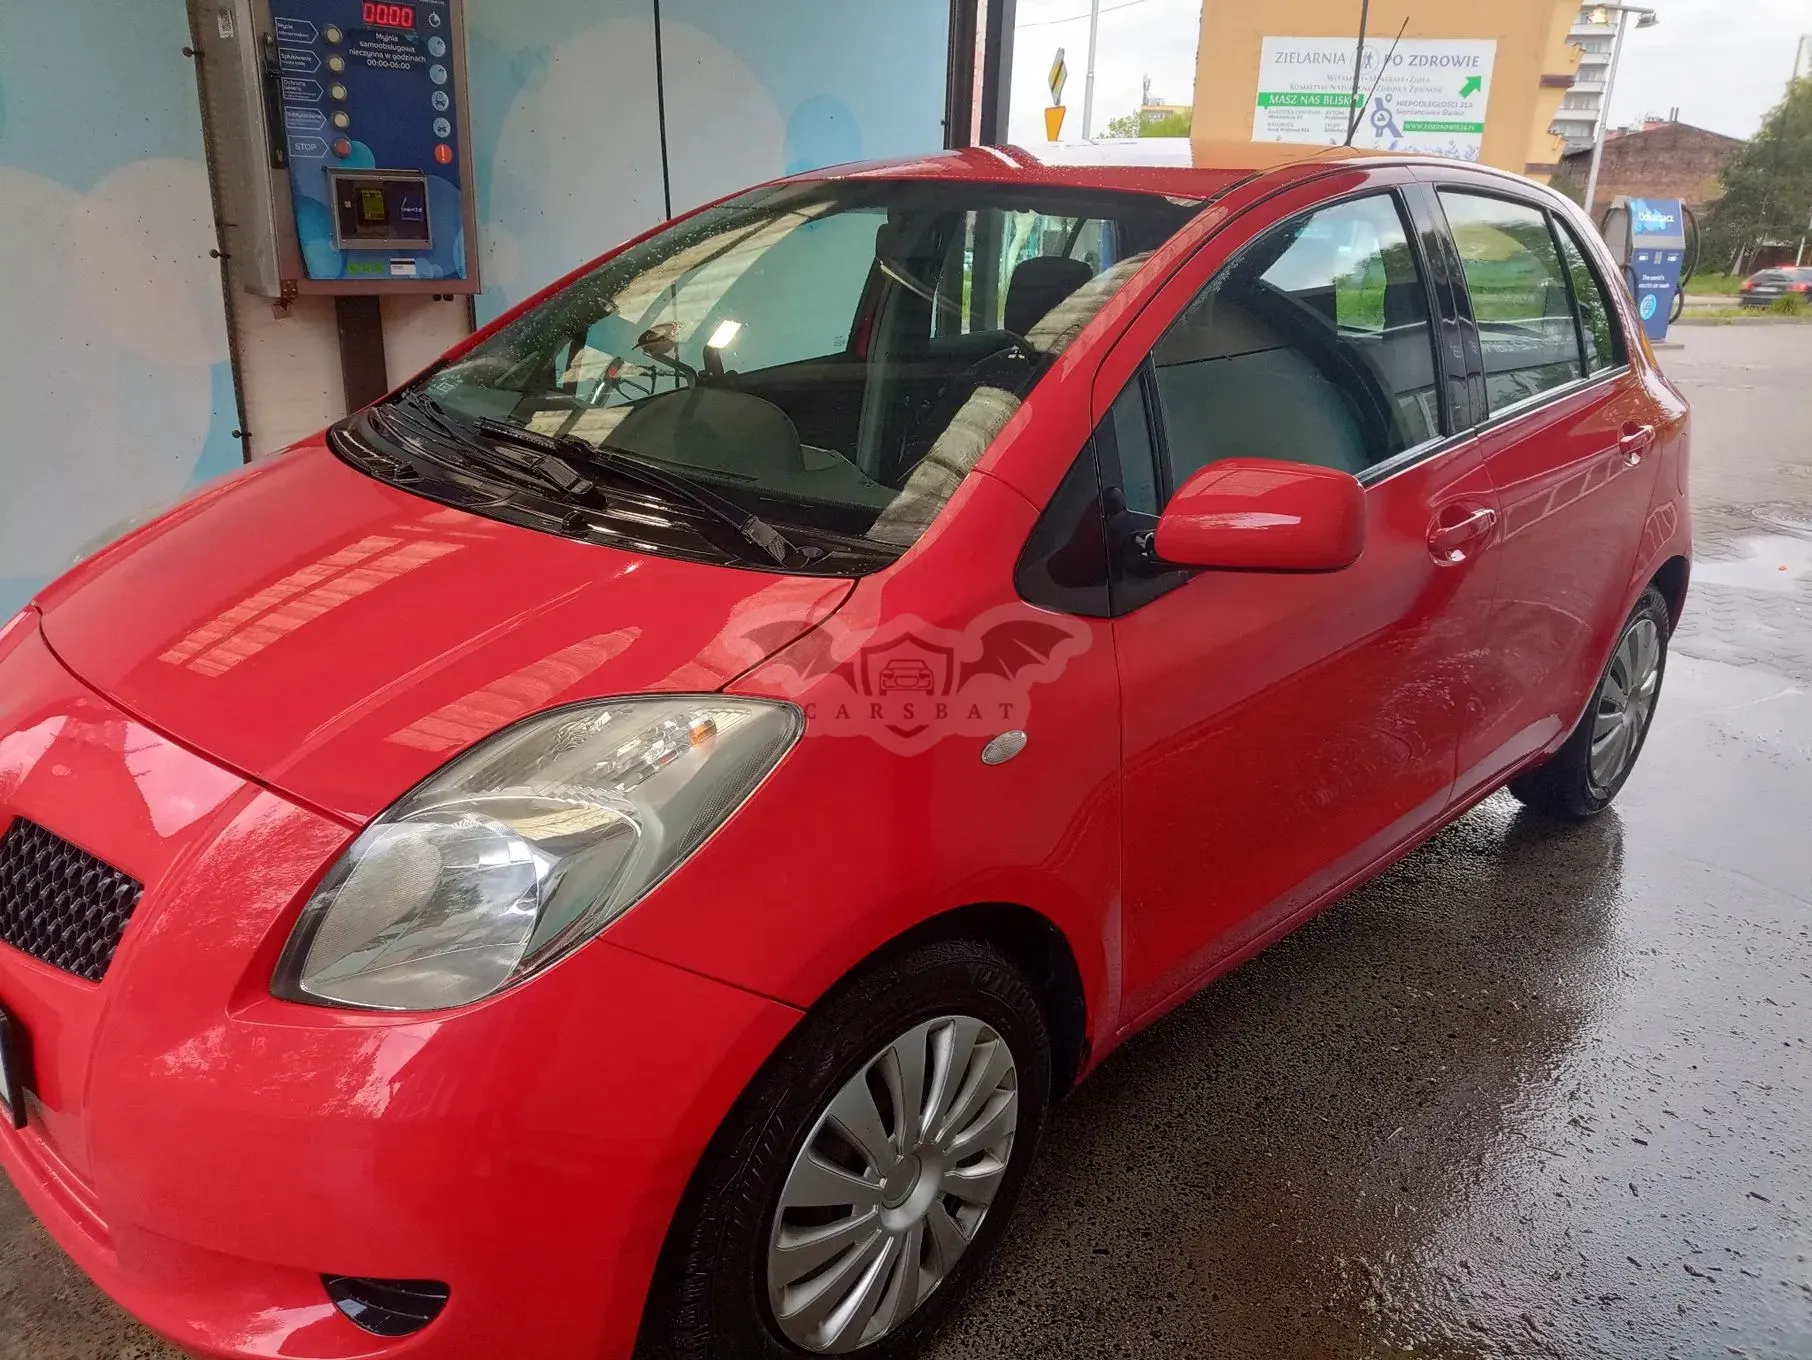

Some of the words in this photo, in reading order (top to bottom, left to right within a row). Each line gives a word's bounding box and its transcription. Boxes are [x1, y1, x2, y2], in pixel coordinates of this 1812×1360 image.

[375, 33, 399, 42] Myjnia
[359, 41, 416, 53] samoobsługowa
[349, 49, 384, 59] nieczynna
[392, 53, 427, 63] godzinach
[1275, 51, 1346, 65] ZIELARNIA
[1385, 54, 1403, 66] PO
[1409, 54, 1480, 68] ZDROWIE
[367, 59, 411, 70] 00:00-06:00
[1269, 94, 1297, 104] MASZ
[1300, 95, 1320, 104] NAS
[295, 143, 317, 151] STOP
